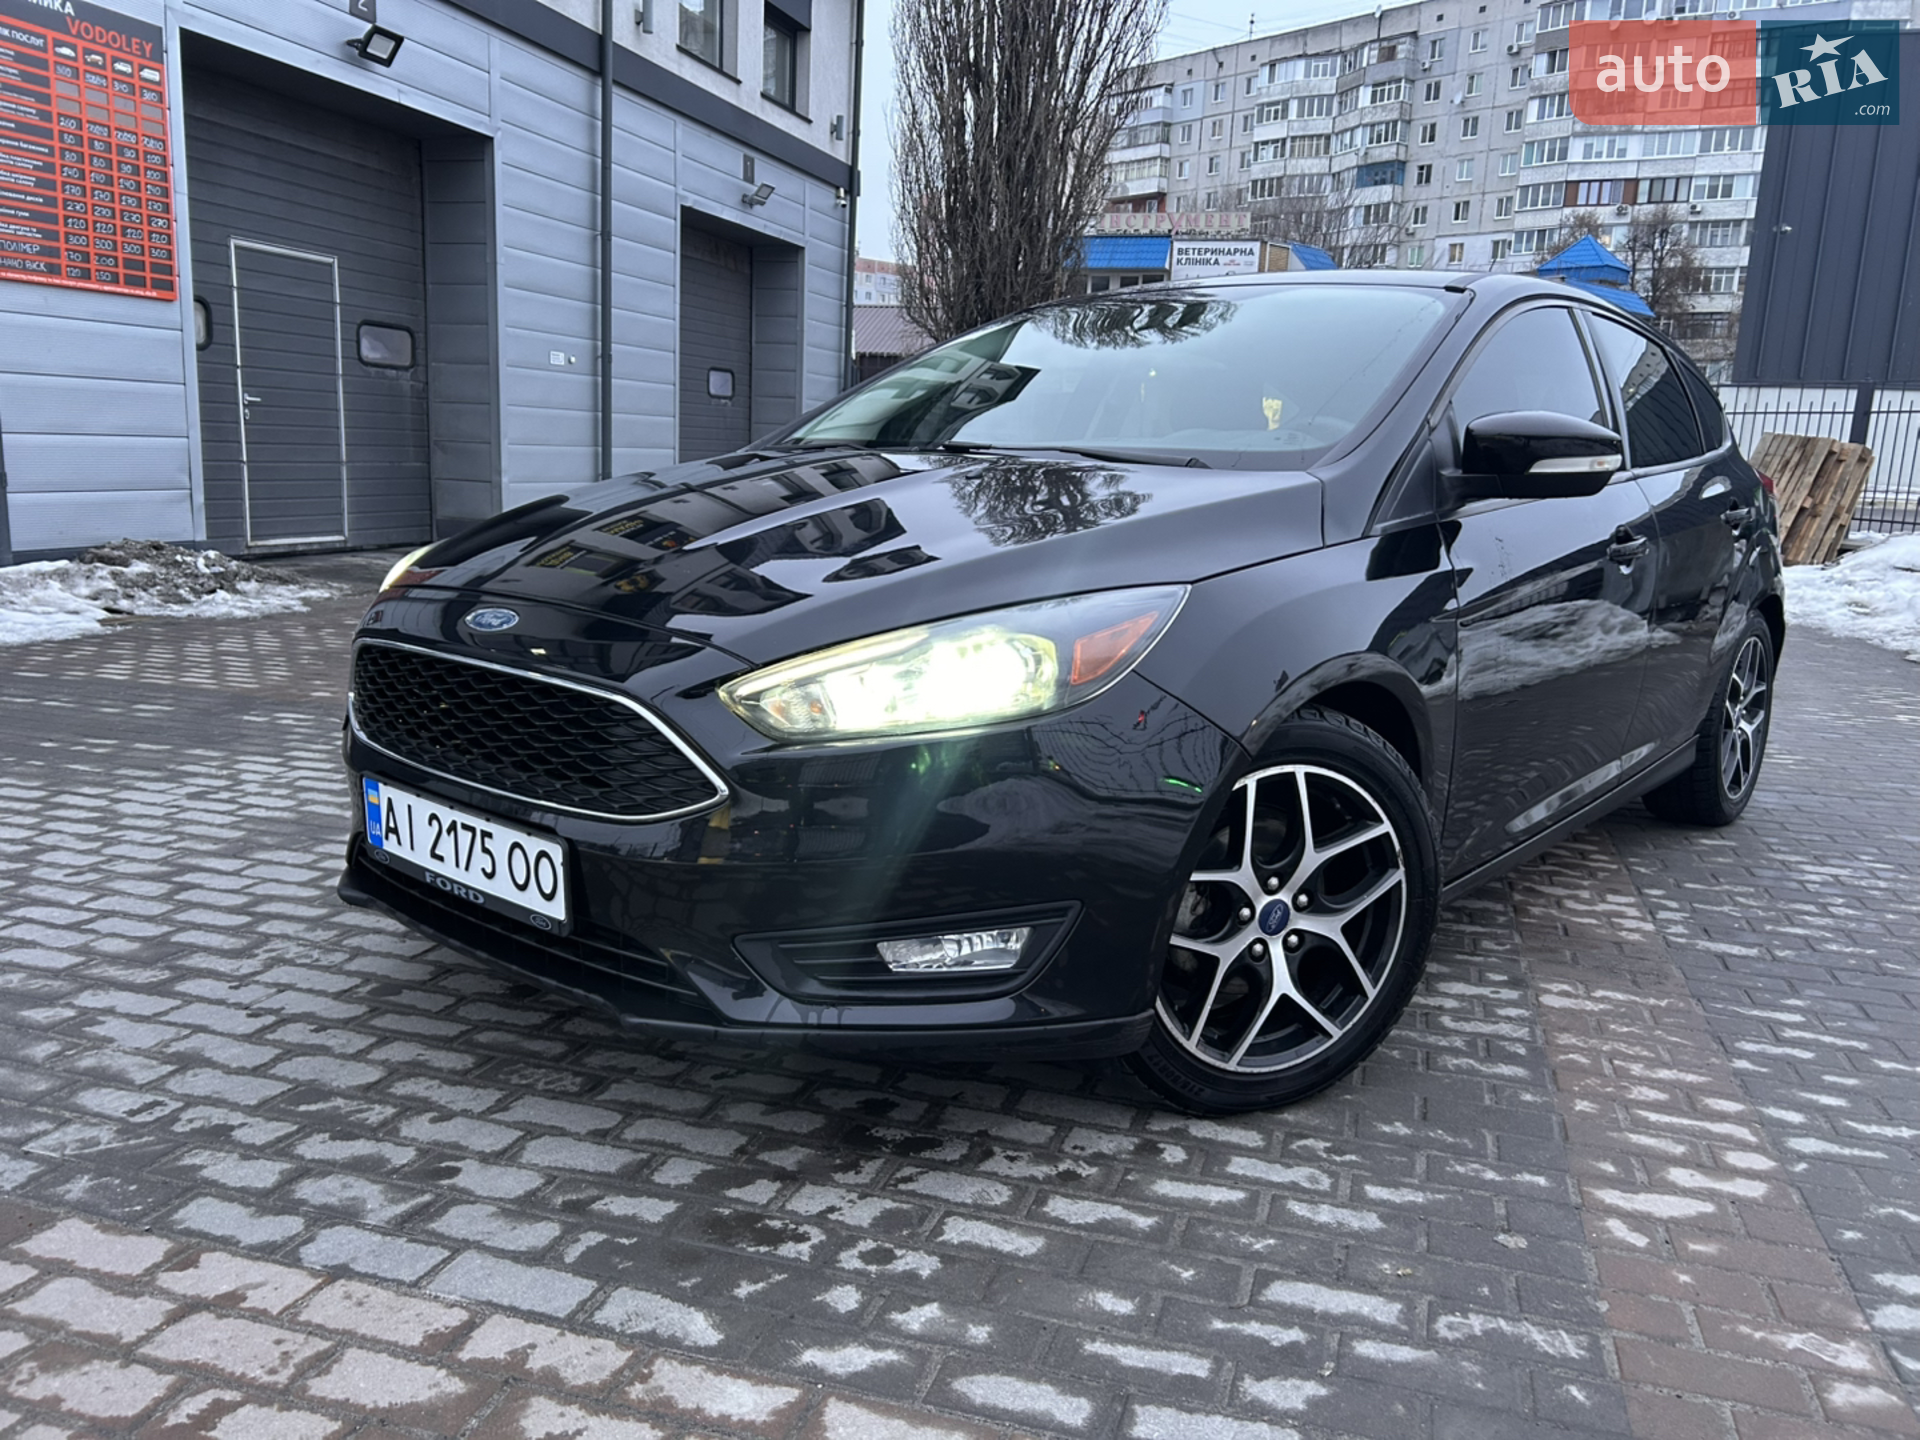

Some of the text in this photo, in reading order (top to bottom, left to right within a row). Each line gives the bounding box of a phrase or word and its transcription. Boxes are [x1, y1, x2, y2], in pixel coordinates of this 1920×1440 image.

[66, 16, 153, 58] VODOLEY
[66, 217, 87, 230] 120
[94, 222, 114, 234] 120
[1176, 247, 1255, 257] ВЕТЕРИНАРНА
[1176, 257, 1220, 267] КЛІНІКА
[370, 820, 382, 837] UA
[384, 796, 415, 852] AI
[428, 812, 496, 880] 2175
[424, 871, 485, 904] FORD
